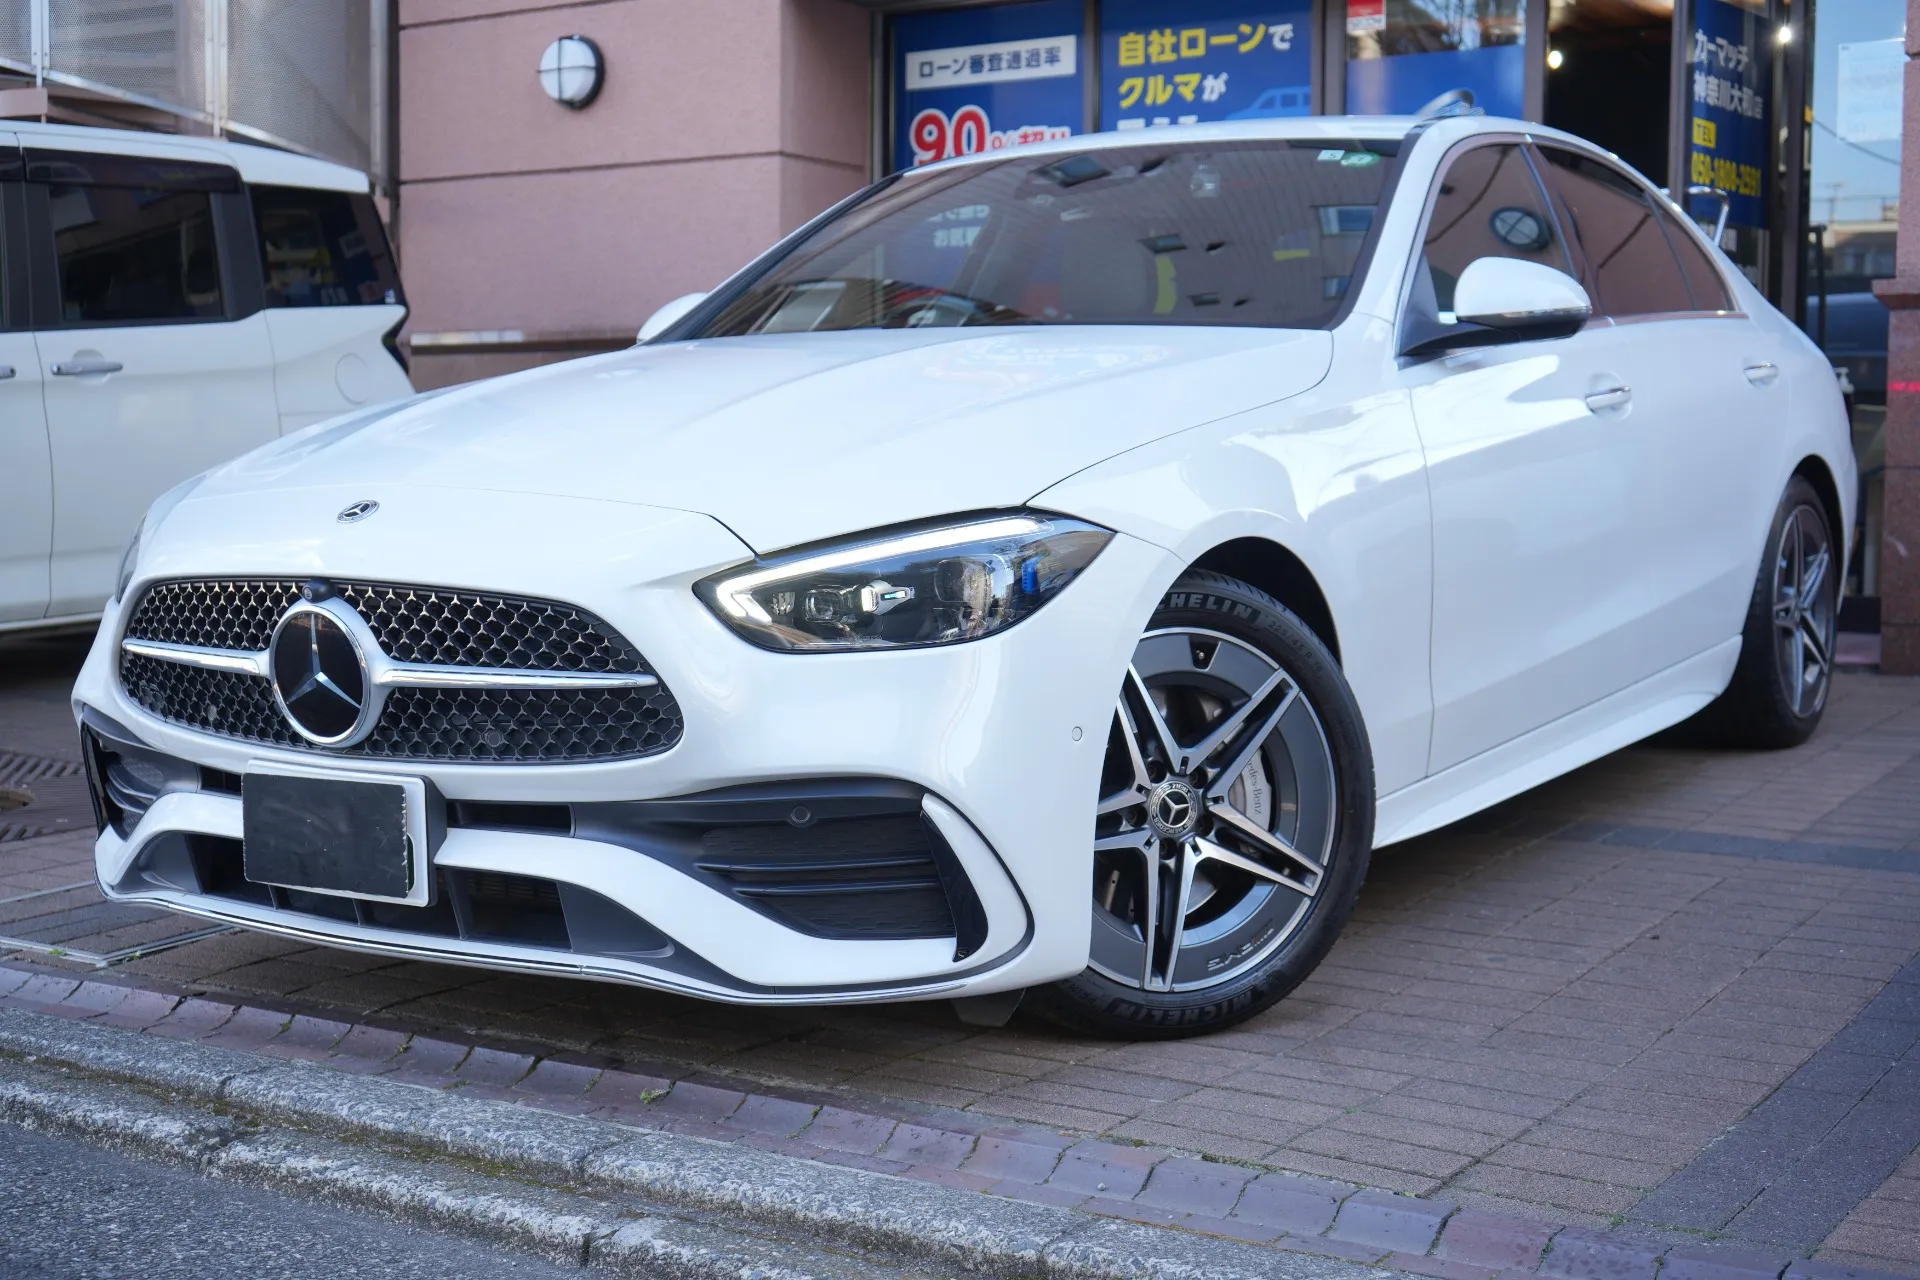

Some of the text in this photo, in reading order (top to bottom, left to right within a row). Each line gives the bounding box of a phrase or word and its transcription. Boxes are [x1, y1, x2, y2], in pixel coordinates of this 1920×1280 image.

[919, 46, 1061, 78] ローン審査通過率
[1118, 23, 1294, 67] 自社ローンで
[1694, 28, 1749, 72] カーマッチ
[1118, 72, 1229, 110] クルマが
